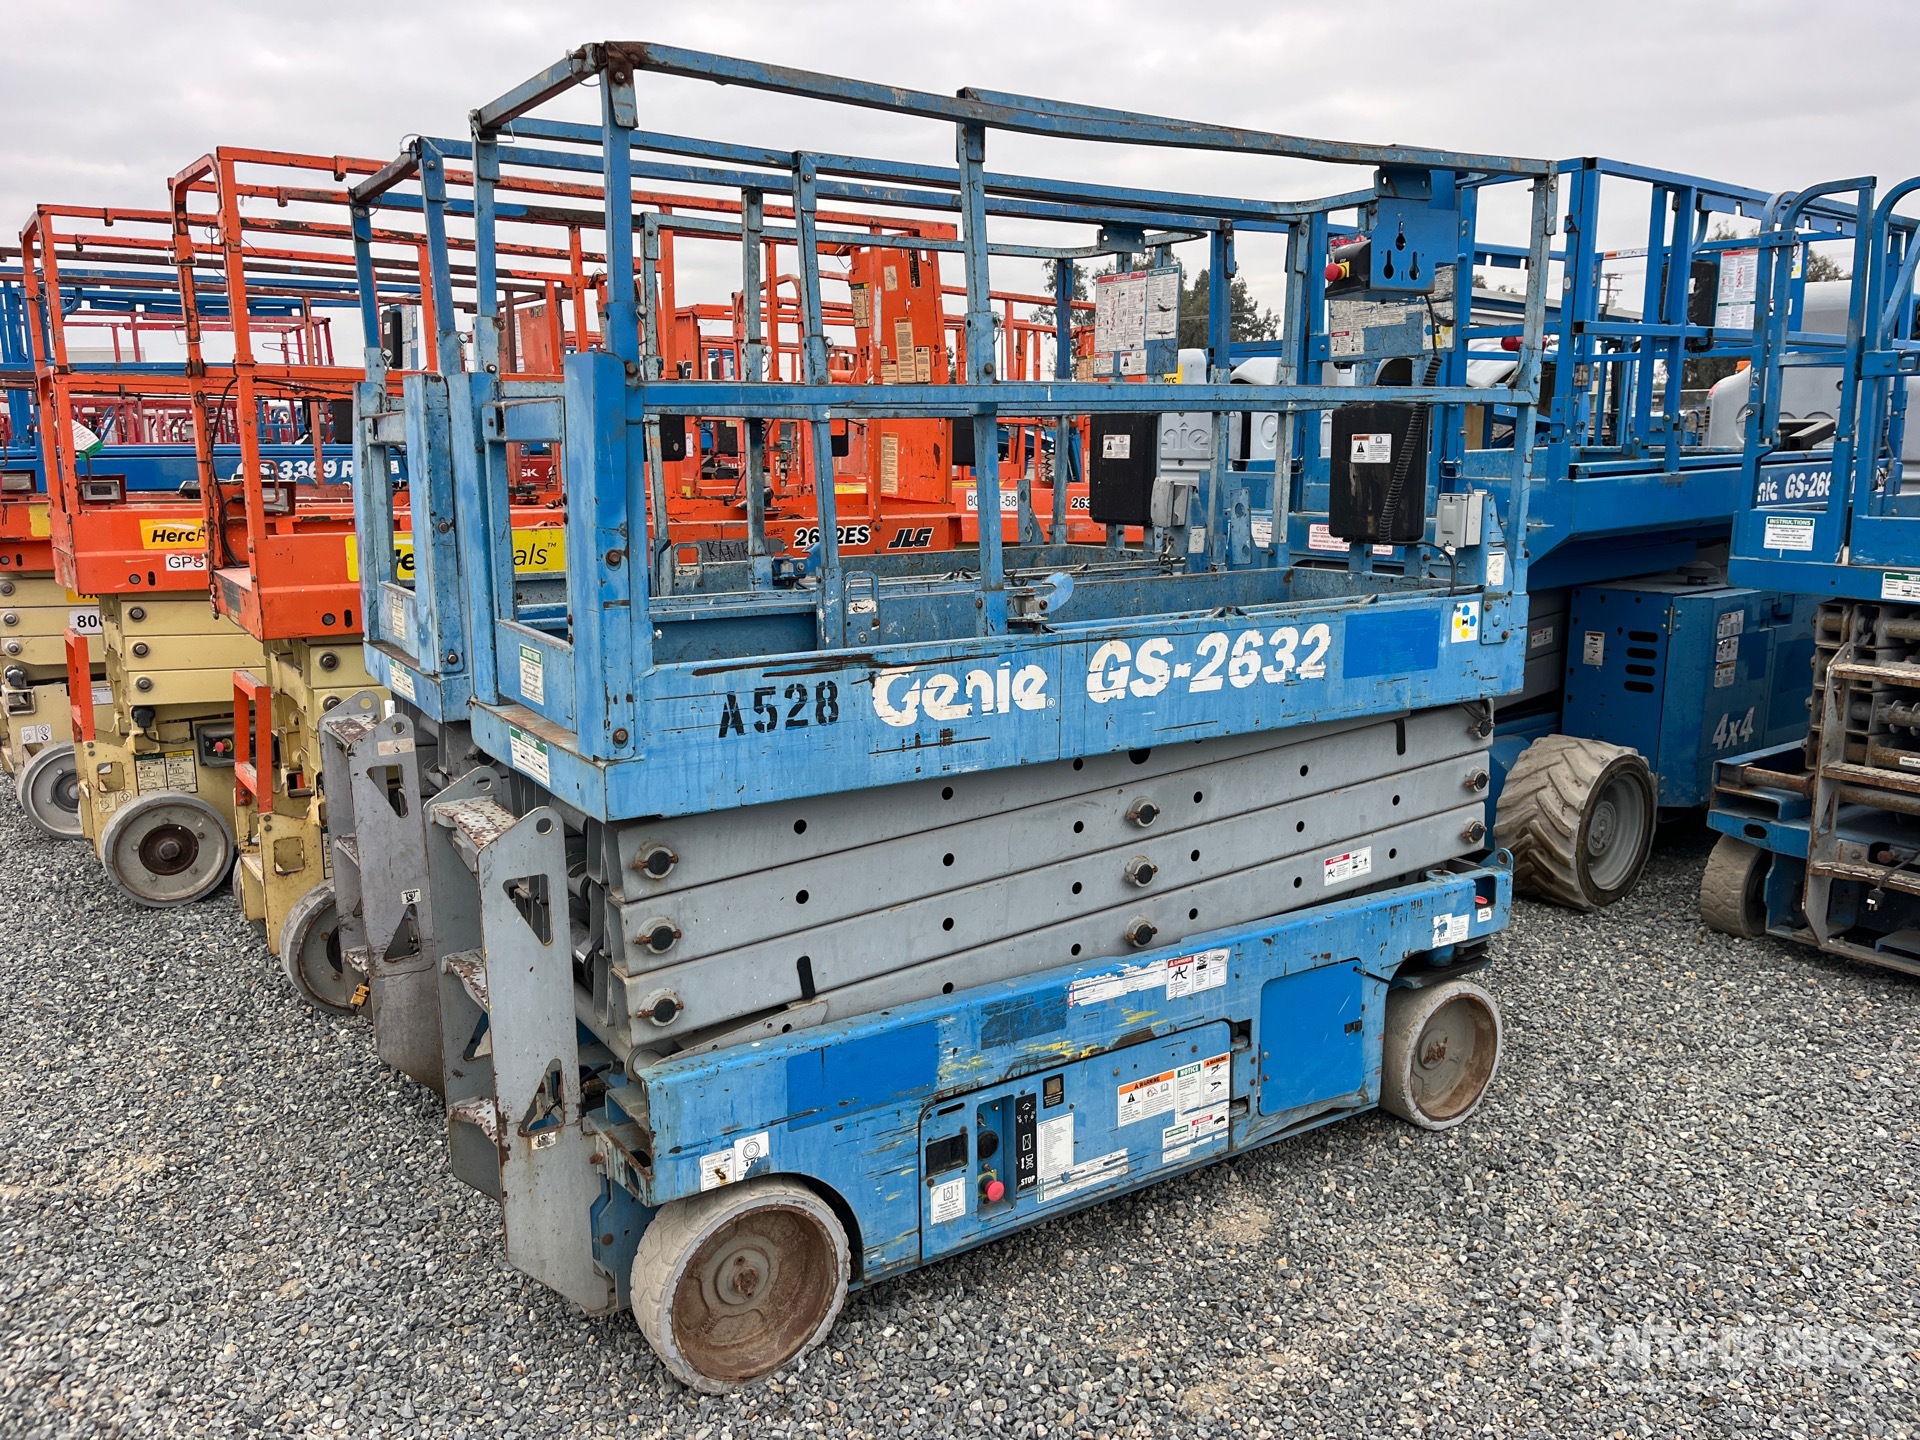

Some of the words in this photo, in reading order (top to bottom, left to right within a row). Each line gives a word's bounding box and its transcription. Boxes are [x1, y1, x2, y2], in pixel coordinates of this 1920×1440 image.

[887, 527, 936, 549] JLG
[1085, 622, 1332, 704] GS-2632
[717, 680, 840, 739] A528
[1711, 706, 1756, 751] 4x4
[1174, 956, 1193, 966] DANGER
[1209, 1055, 1227, 1065] WARNING
[1180, 1064, 1200, 1077] NOTICE
[1139, 1075, 1161, 1088] WARNING
[1020, 1174, 1036, 1187] STOP
